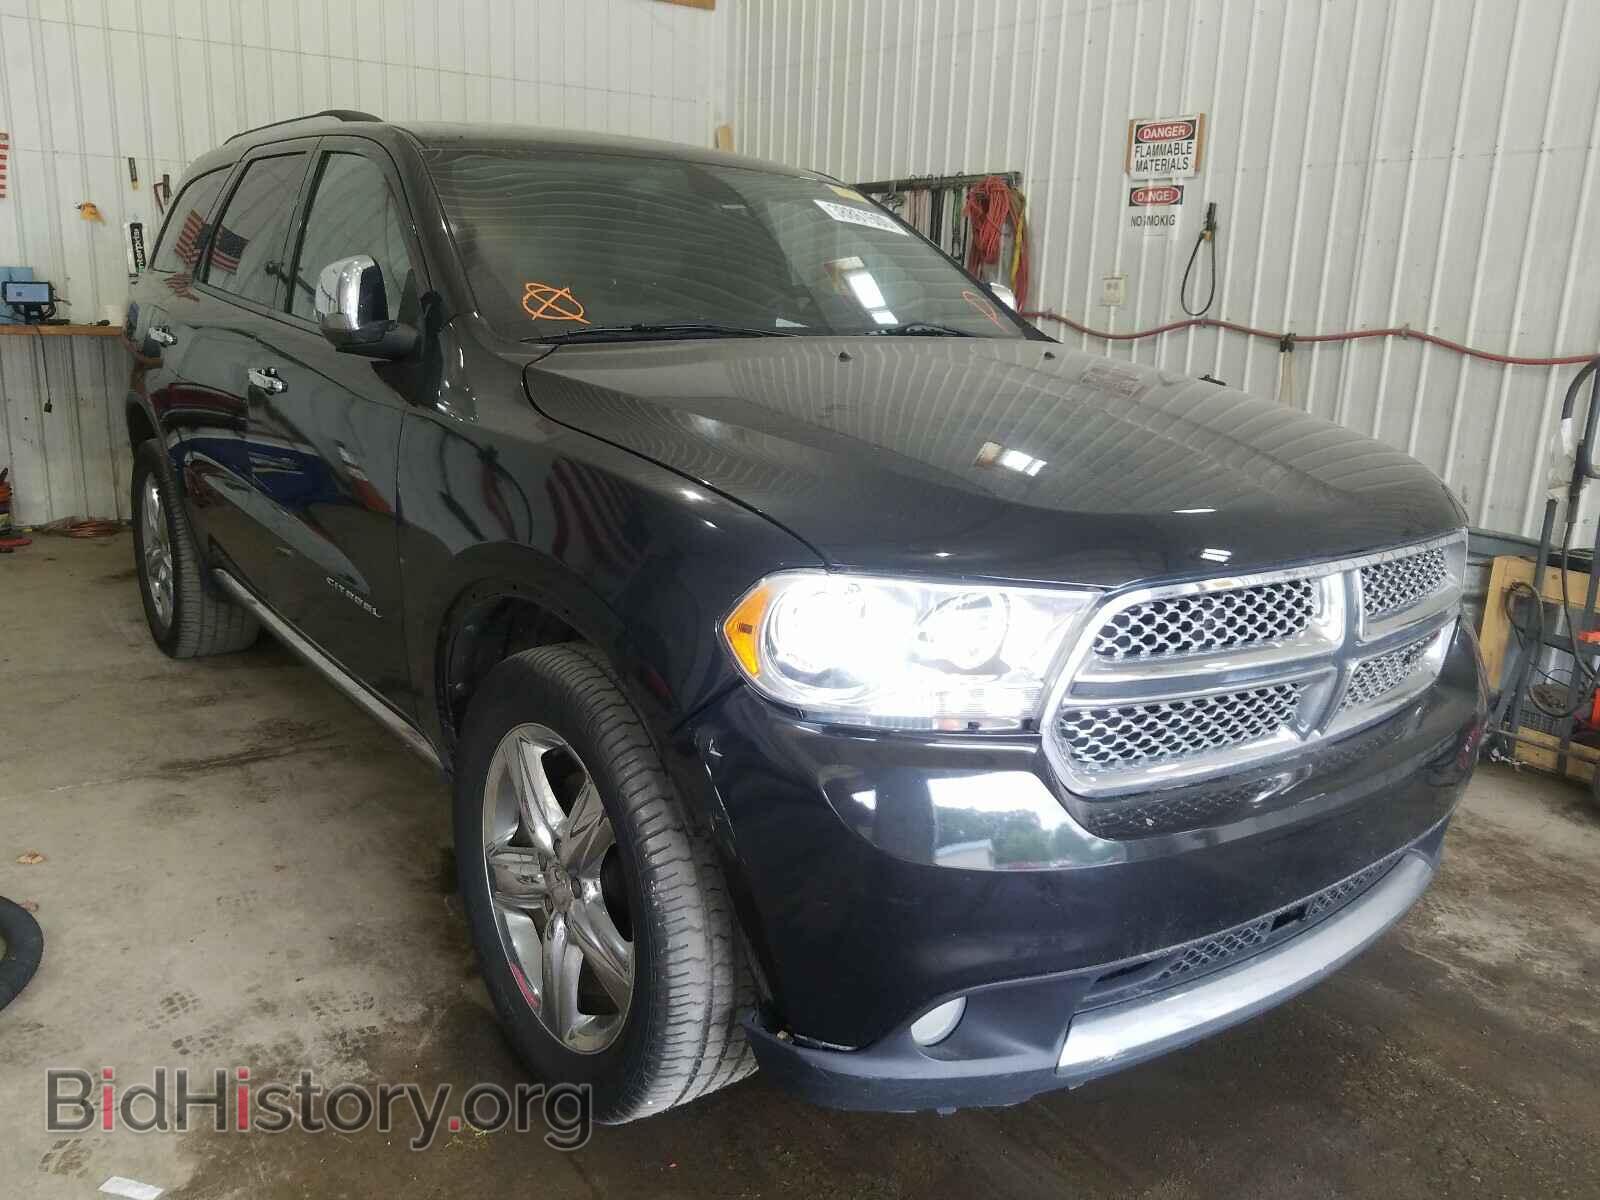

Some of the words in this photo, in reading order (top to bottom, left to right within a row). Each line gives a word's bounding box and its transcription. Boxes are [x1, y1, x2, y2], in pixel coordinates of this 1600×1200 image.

[1143, 125, 1186, 139] DANGER
[1135, 142, 1192, 158] FLAMMABLE
[1136, 157, 1189, 173] MATERIALS
[1137, 190, 1173, 202] DNGE
[1131, 215, 1142, 227] NO
